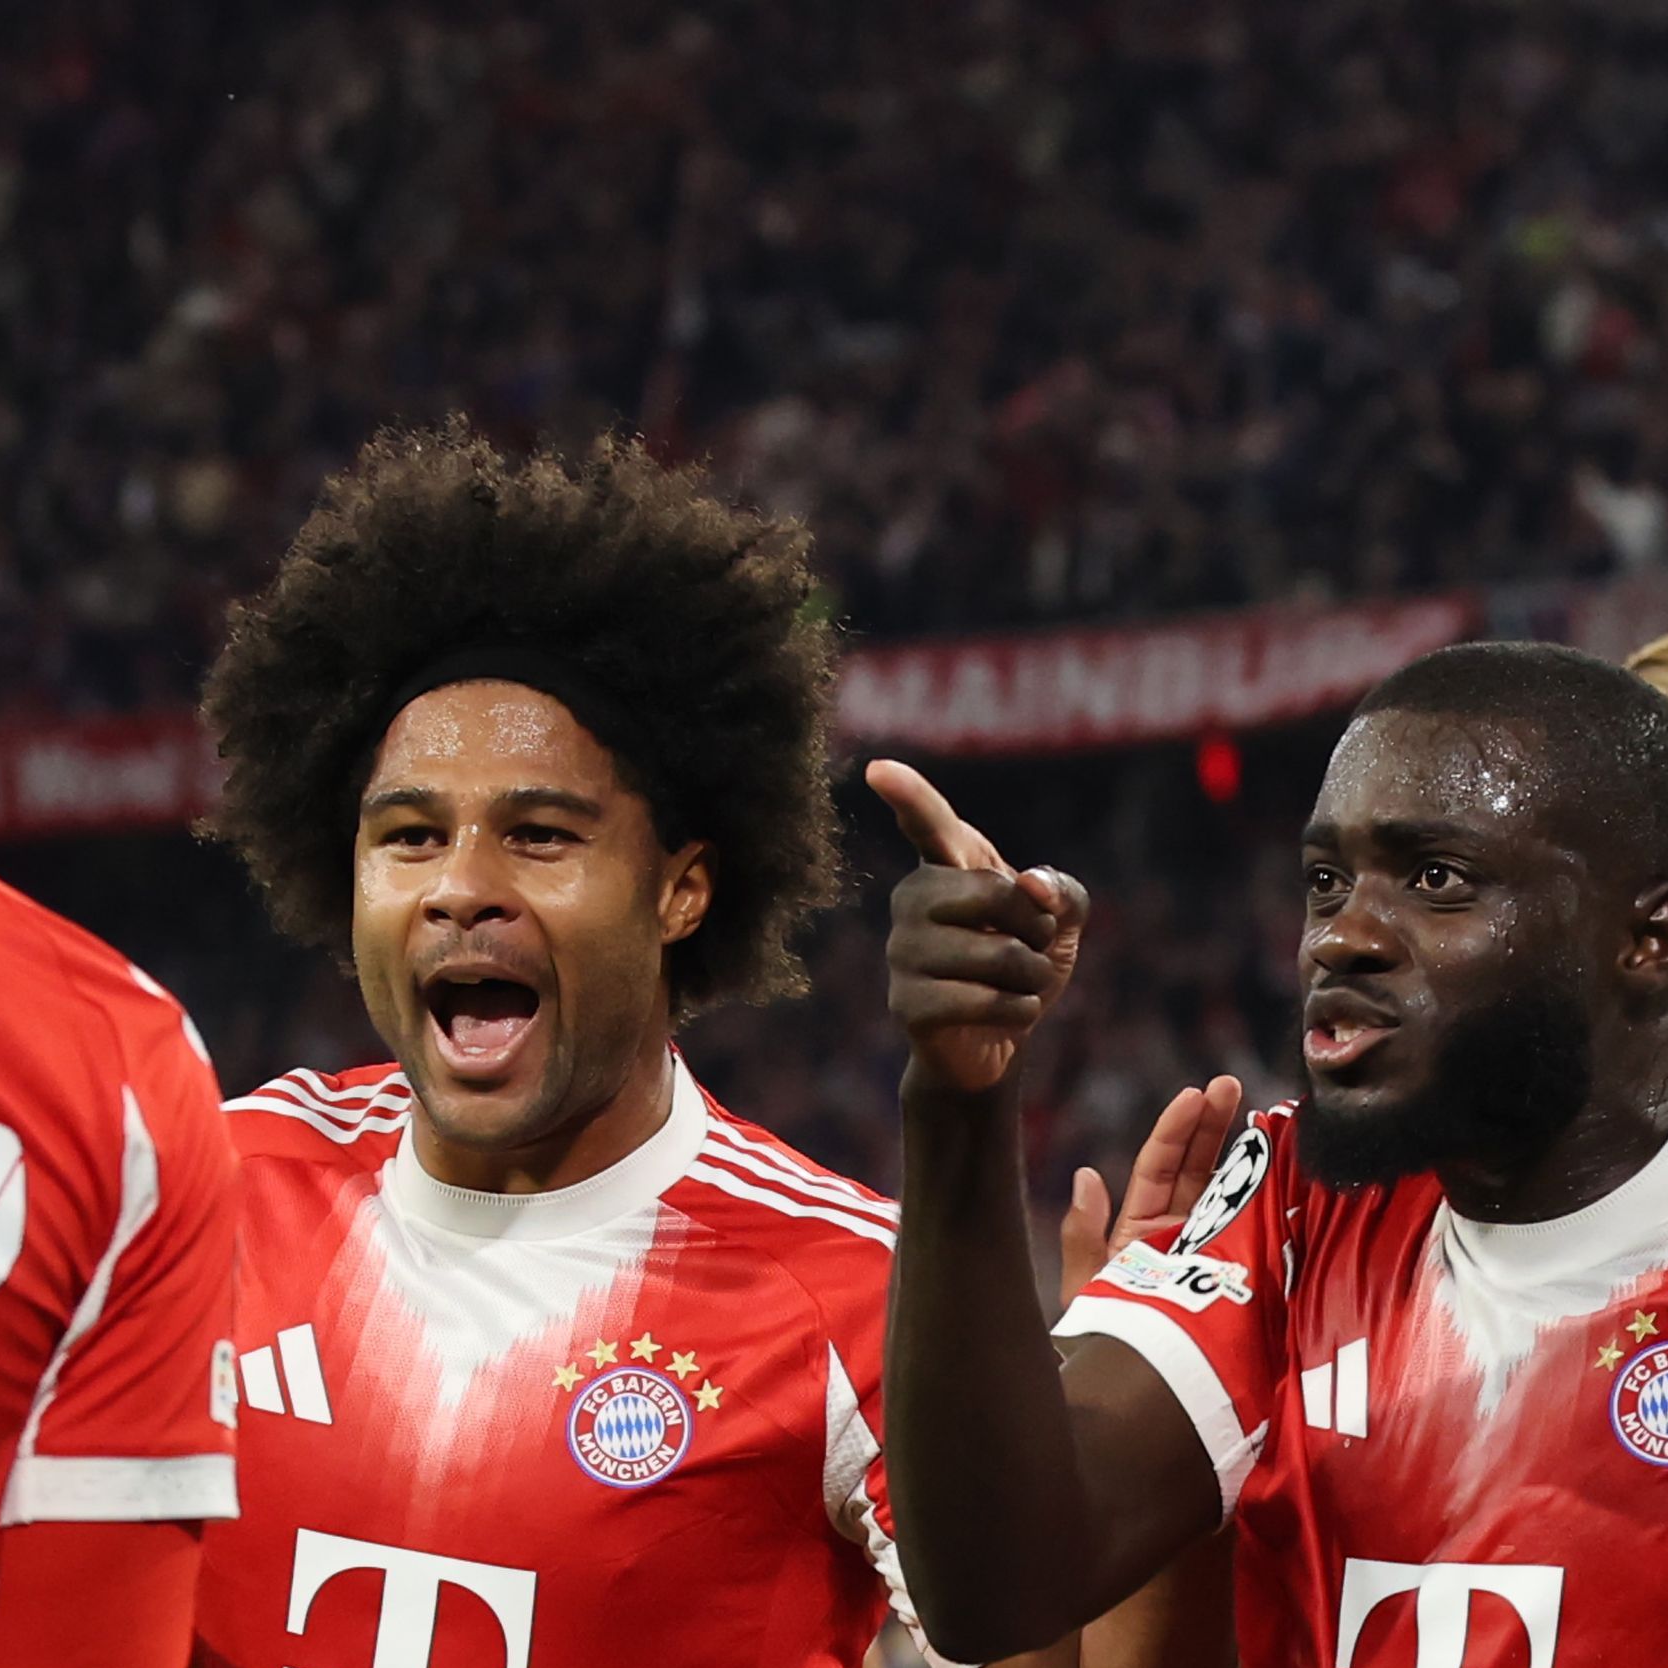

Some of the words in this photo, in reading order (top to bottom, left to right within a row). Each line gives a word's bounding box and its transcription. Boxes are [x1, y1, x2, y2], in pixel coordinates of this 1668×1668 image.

[581, 1387, 609, 1415] FC
[609, 1375, 683, 1427] BAYERN
[1623, 1363, 1651, 1394] FC
[576, 1432, 676, 1480] MÜNCHEN
